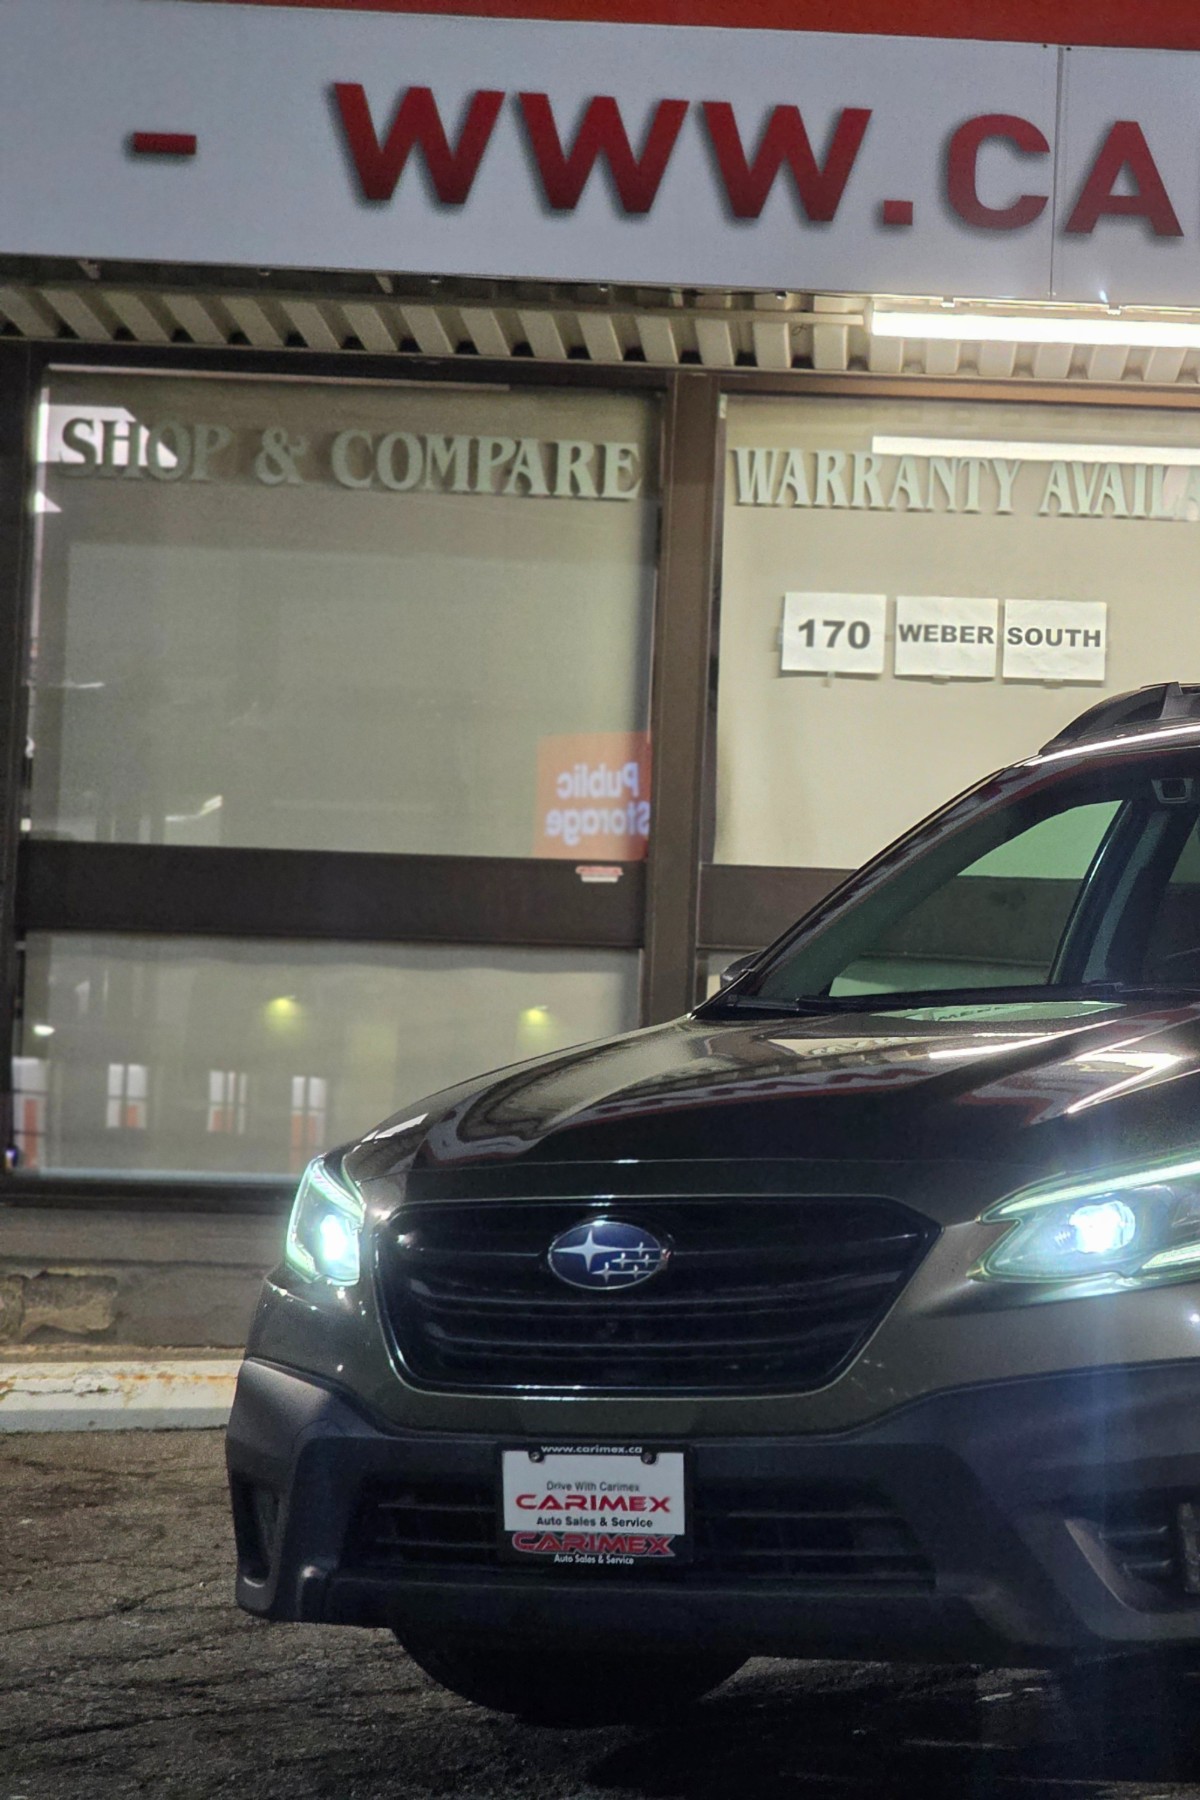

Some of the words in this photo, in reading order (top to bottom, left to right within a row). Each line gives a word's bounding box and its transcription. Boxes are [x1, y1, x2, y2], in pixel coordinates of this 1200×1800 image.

[58, 417, 233, 481] SHOP
[255, 426, 310, 486] &
[331, 427, 644, 500] COMPARE
[731, 446, 1022, 516] WARRANTY
[798, 619, 871, 650] 170
[898, 623, 995, 645] WEBER
[1007, 626, 1101, 648] SOUTH
[540, 1444, 643, 1454] www.carimex.ca
[546, 1481, 572, 1491] Drive
[575, 1481, 597, 1491] With
[599, 1482, 640, 1492] Carimex
[515, 1494, 672, 1513] CARIMEX
[536, 1516, 563, 1526] Auto
[565, 1516, 596, 1527] Sales
[599, 1517, 608, 1527] &
[611, 1518, 654, 1528] Service
[512, 1531, 675, 1556] CARIMEX
[553, 1554, 574, 1563] Auto
[575, 1554, 596, 1564] Sales
[606, 1555, 635, 1565] Service
